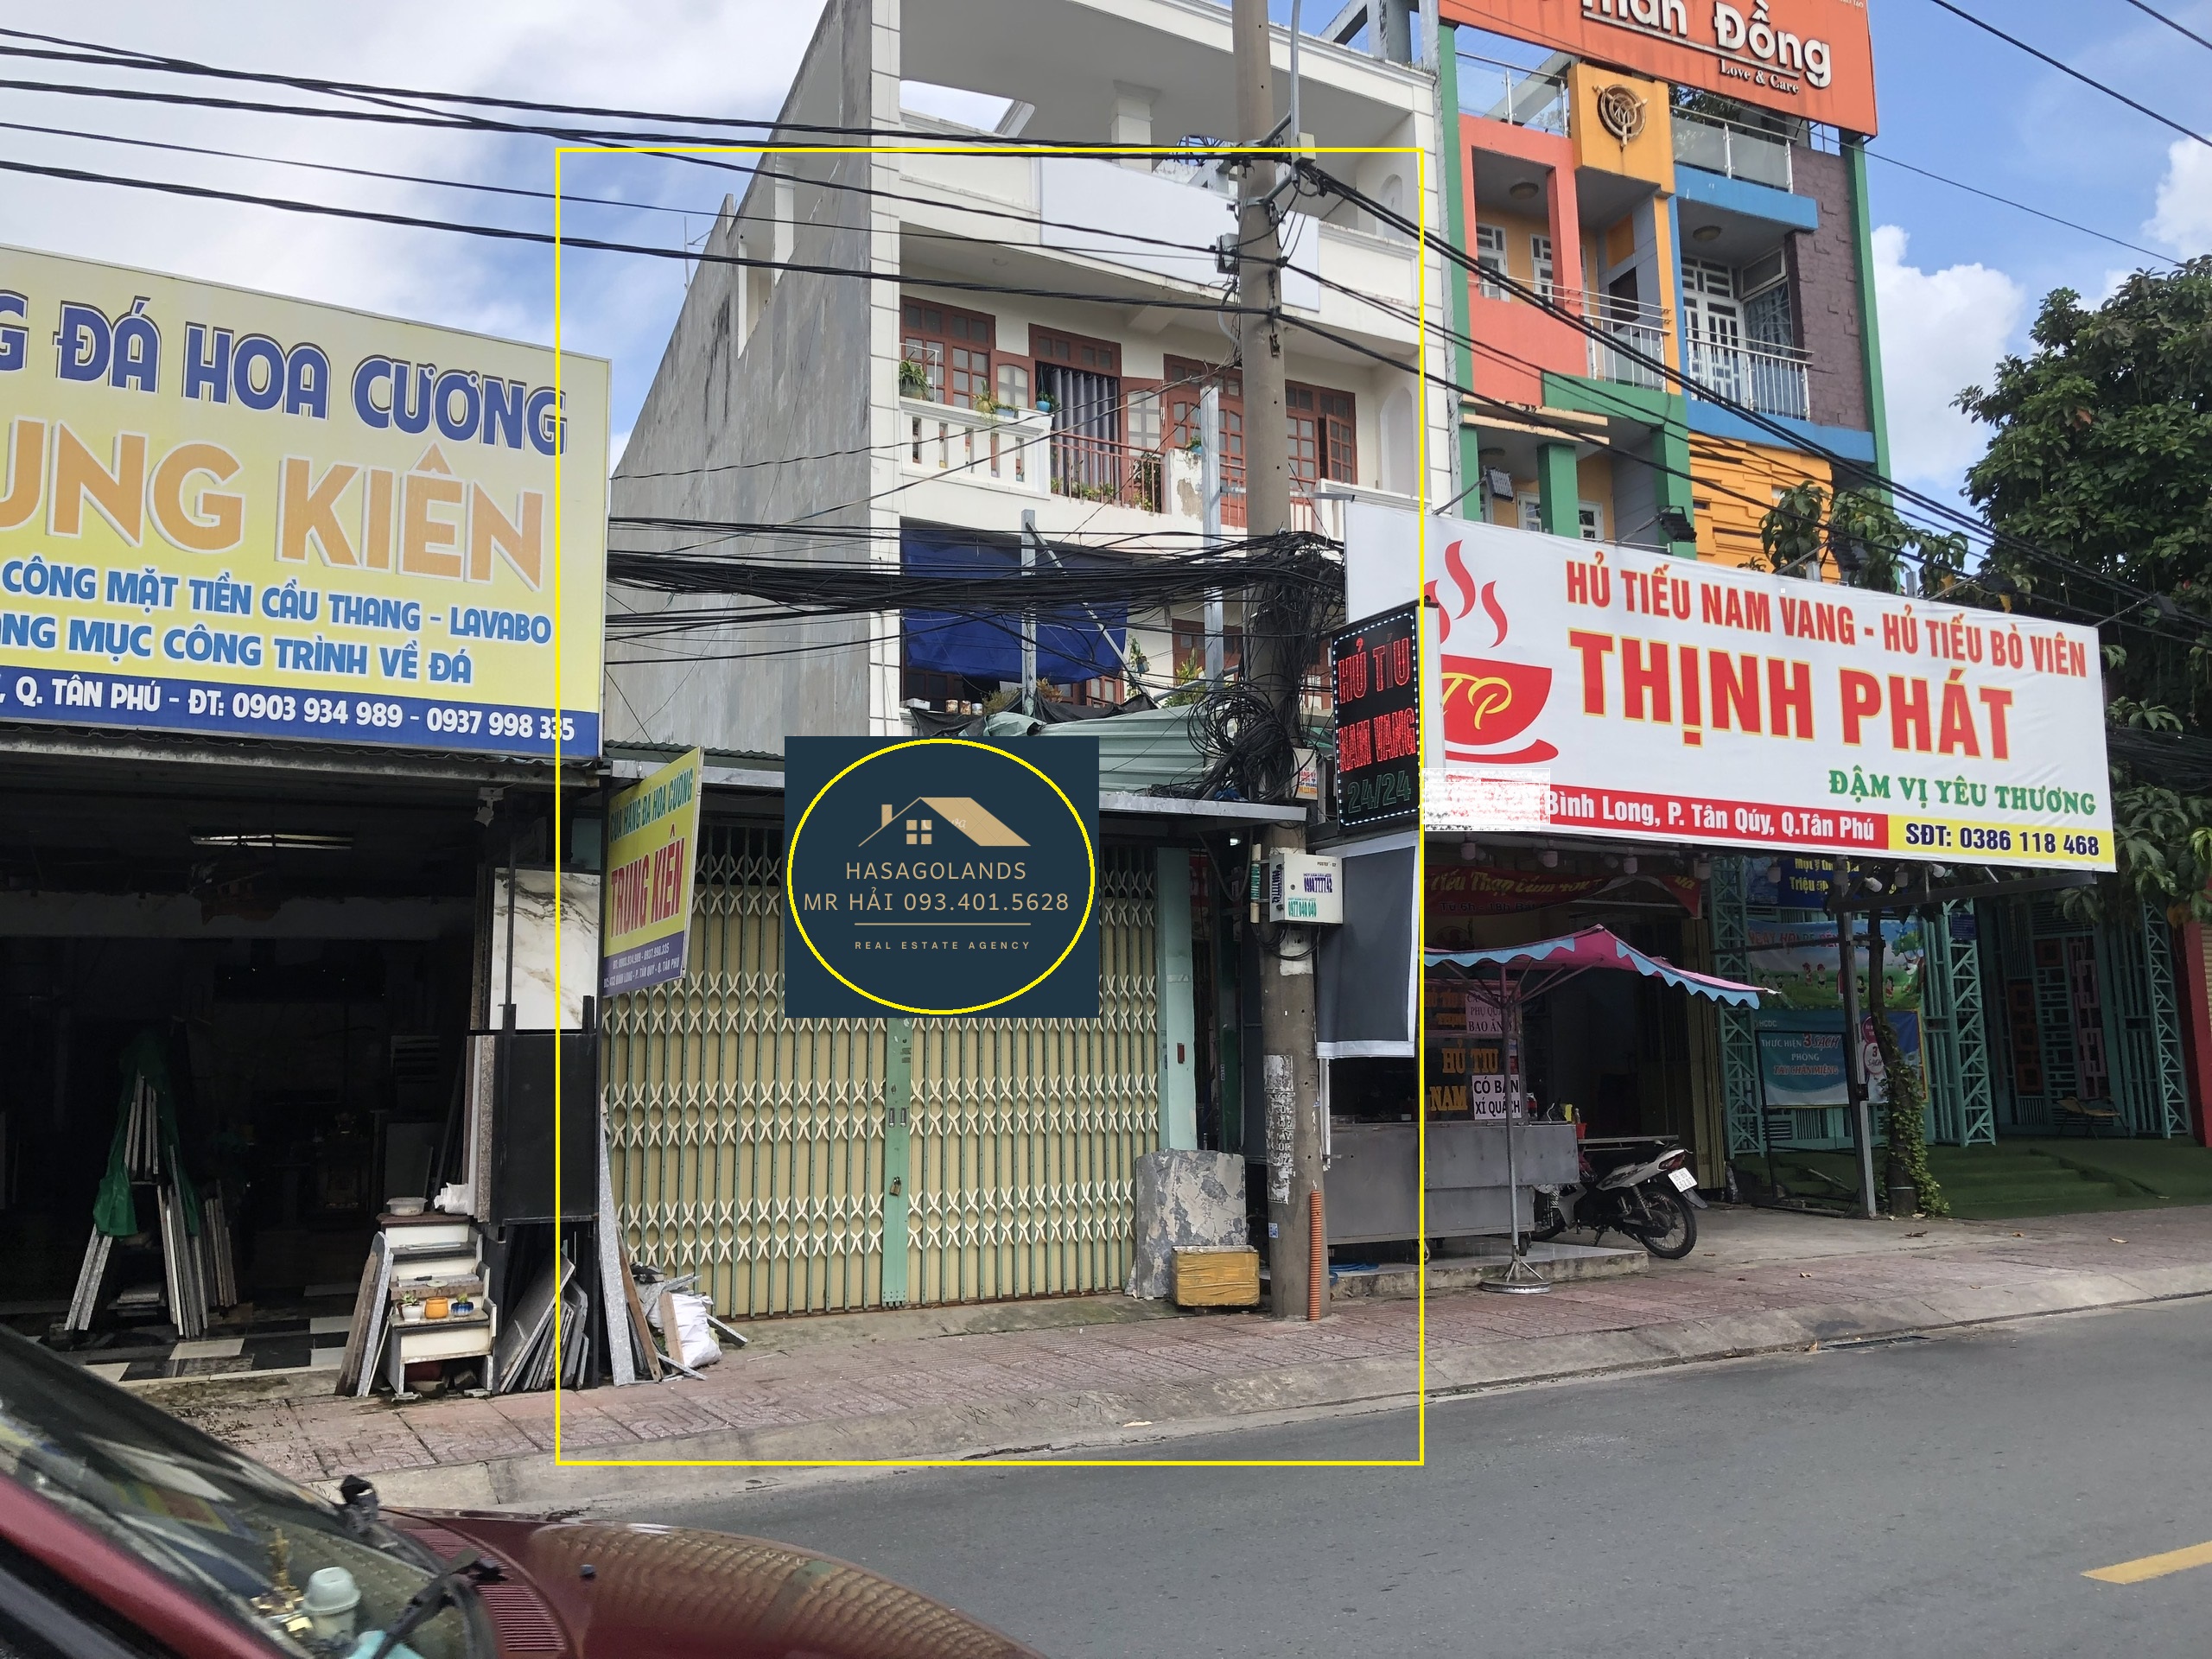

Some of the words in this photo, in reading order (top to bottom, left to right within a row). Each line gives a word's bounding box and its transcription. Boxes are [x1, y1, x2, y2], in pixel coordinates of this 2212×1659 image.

[1713, 0, 1832, 90] Đồng
[1719, 59, 1751, 81] Love
[1755, 70, 1767, 86] &
[1770, 72, 1800, 95] Care
[52, 296, 162, 394] ĐÁ
[181, 321, 333, 421] HOA
[351, 353, 568, 456] CƯƠNG
[276, 441, 545, 593] KIÊN
[3, 556, 97, 601] CÔNG
[106, 567, 180, 613] MẶT
[188, 571, 252, 615] TIỀN
[262, 578, 319, 621] CẦU
[328, 594, 421, 632] THANG
[449, 607, 552, 645] LAVABO
[1565, 550, 1611, 608] HỦ
[1619, 564, 1692, 621] TIẾU
[1700, 582, 1772, 633] NAM
[1778, 594, 1856, 646] VANG
[1881, 604, 1918, 655] HỦ
[1925, 613, 1983, 664] TIẾU
[1990, 624, 2024, 670] BÒ
[2029, 631, 2088, 678] VIÊN
[0, 613, 57, 649] NG
[68, 619, 153, 663] MỤC
[163, 623, 263, 667] CÔNG
[273, 635, 368, 676] TRÌNH
[378, 639, 418, 680] VỀ
[428, 648, 472, 684] ĐÁ
[1338, 637, 1368, 705] HỦ
[15, 675, 43, 708] Q.
[51, 673, 104, 709] TÂN
[110, 680, 162, 713] PHÚ
[188, 688, 226, 717] ĐT:
[232, 691, 297, 721] 0903
[303, 696, 349, 725] 934
[355, 700, 404, 728] 989
[426, 707, 483, 734] 0937
[488, 711, 534, 738] 998
[1567, 626, 1815, 748] THỊNH
[1838, 666, 2013, 762] PHÁT
[1338, 719, 1372, 772] NAM
[1373, 707, 1417, 762] VANG
[652, 784, 667, 822] HOA
[1346, 769, 1413, 814] 24/24
[1828, 763, 1891, 804] ĐẬM
[1900, 776, 1928, 810] VỊ
[1936, 774, 1987, 810] YÊU
[1993, 782, 2096, 817] THƯƠNG
[1545, 789, 1596, 820] Bình
[1601, 797, 1662, 827] Long,
[1668, 801, 1684, 826] P.
[1691, 801, 1728, 830] Tân
[1780, 808, 1834, 836] Q.Tân
[1839, 811, 1875, 842] Phú
[1905, 821, 1953, 848] SĐT:
[1959, 825, 2012, 852] 0386
[2019, 830, 2056, 854] 118
[2063, 832, 2101, 857] 468
[610, 854, 650, 939] TRUNG
[650, 823, 685, 925] KIÊN
[1441, 1039, 1466, 1074] HỦ
[1469, 1020, 1488, 1032] BAO
[1802, 1033, 1813, 1048] 3
[1872, 1046, 1878, 1057] 3
[1429, 1085, 1469, 1112] NAM
[1473, 1076, 1491, 1095] CÓ
[1494, 1079, 1519, 1094] BN
[1475, 1096, 1486, 1115] XÍ
[1488, 1095, 1521, 1117] QUÁH
